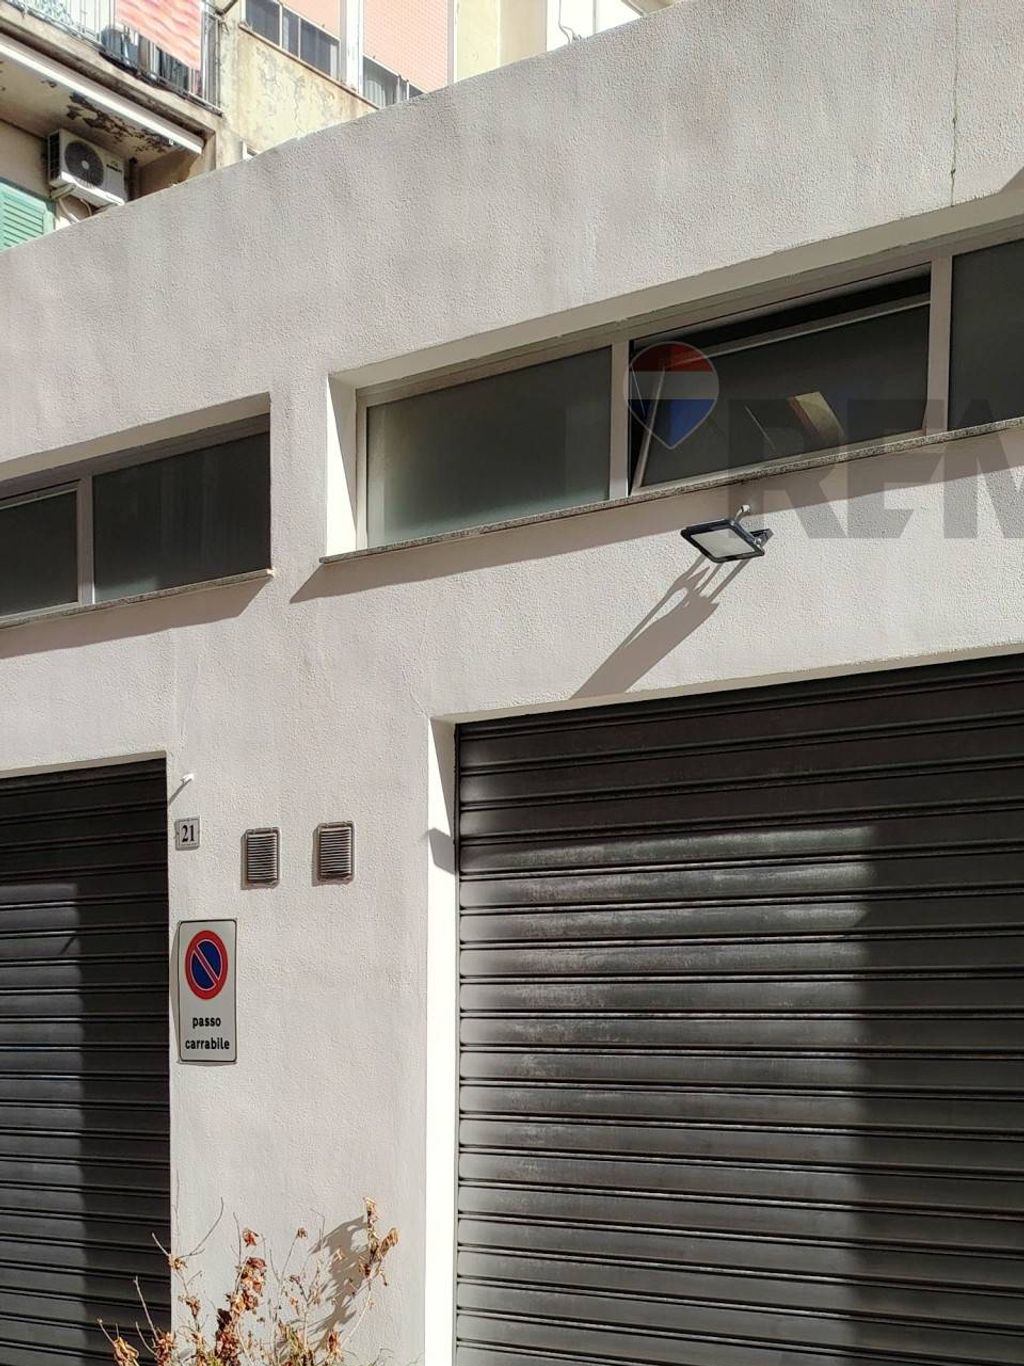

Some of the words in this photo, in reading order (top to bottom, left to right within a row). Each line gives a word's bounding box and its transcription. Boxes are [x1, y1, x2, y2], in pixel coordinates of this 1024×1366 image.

[181, 824, 195, 843] 21
[192, 1017, 221, 1029] passo
[185, 1037, 230, 1050] carrabile
